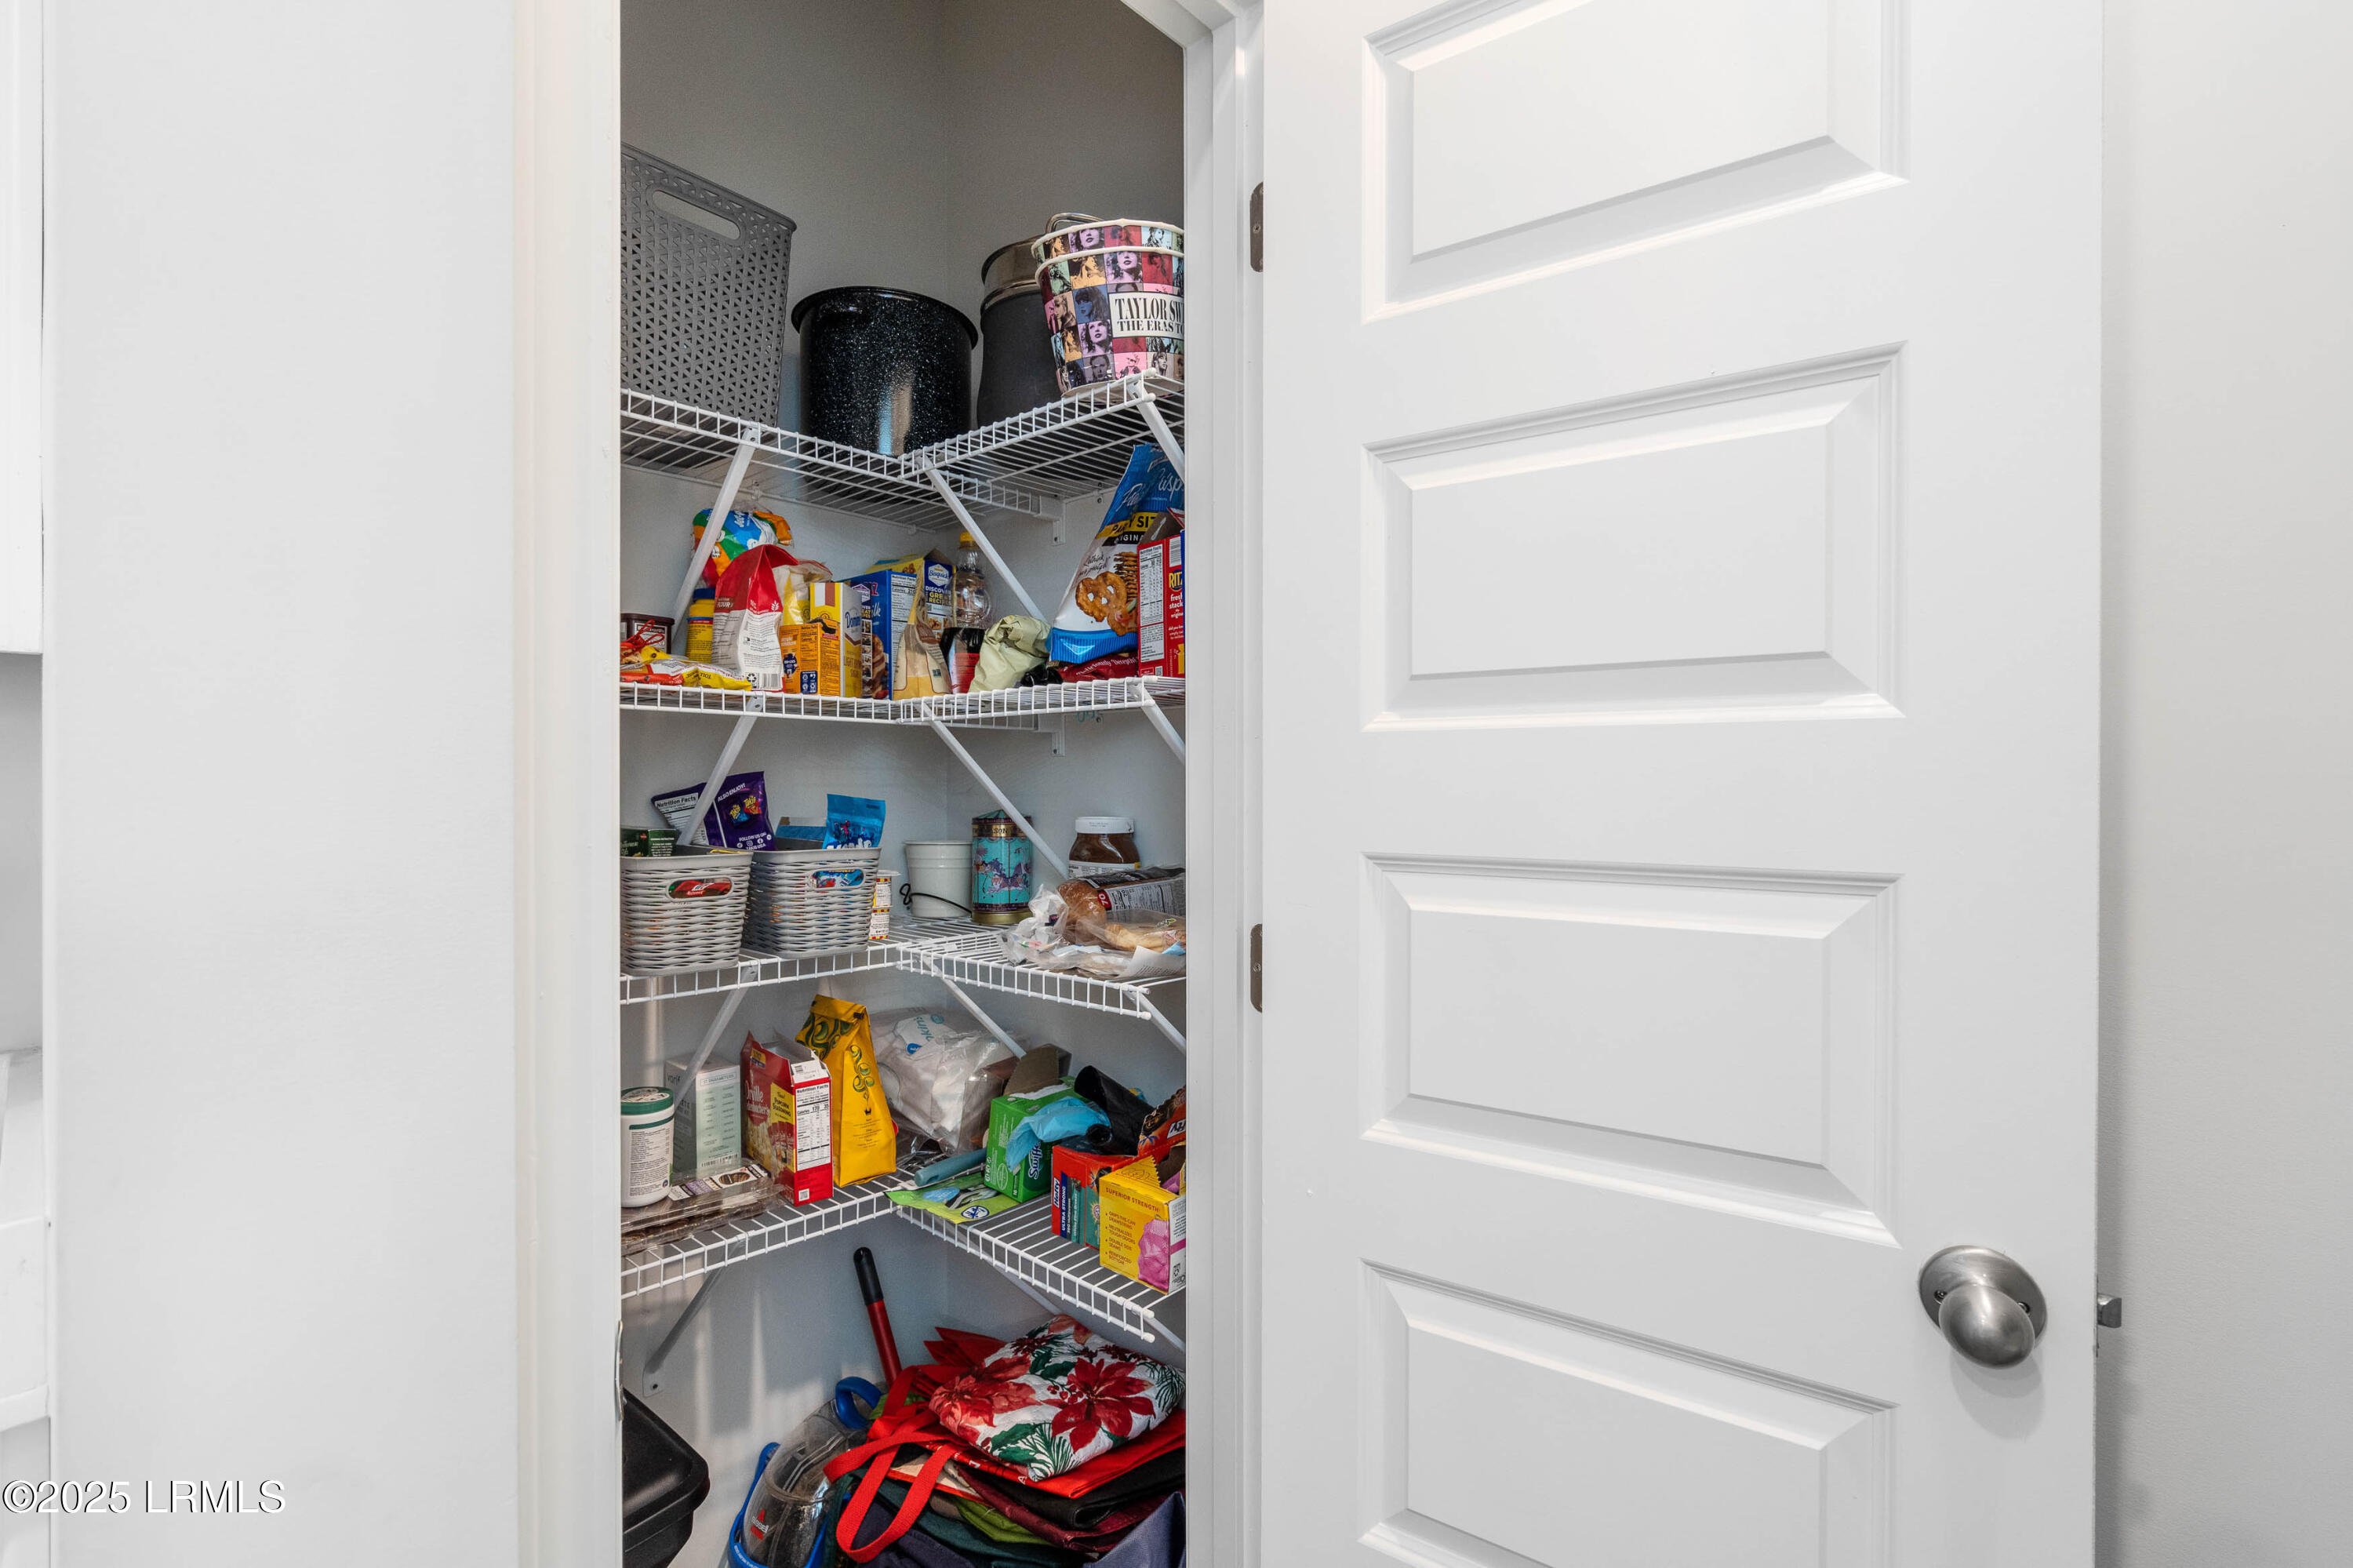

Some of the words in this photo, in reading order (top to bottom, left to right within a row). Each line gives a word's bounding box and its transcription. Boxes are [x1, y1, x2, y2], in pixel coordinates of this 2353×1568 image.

[1115, 298, 1168, 321] TAYLOR
[1169, 300, 1184, 324] SWI
[1117, 320, 1144, 331] THE
[1147, 320, 1174, 333] ERAS
[929, 570, 949, 580] Bisquick
[1169, 571, 1183, 588] RIT
[926, 585, 945, 594] DISCOV
[717, 791, 729, 802] ALSO
[729, 783, 745, 796] ENJOY!
[657, 799, 681, 808] Nutrition
[681, 795, 696, 804] Facts
[1106, 1187, 1131, 1201] SUPERIOR
